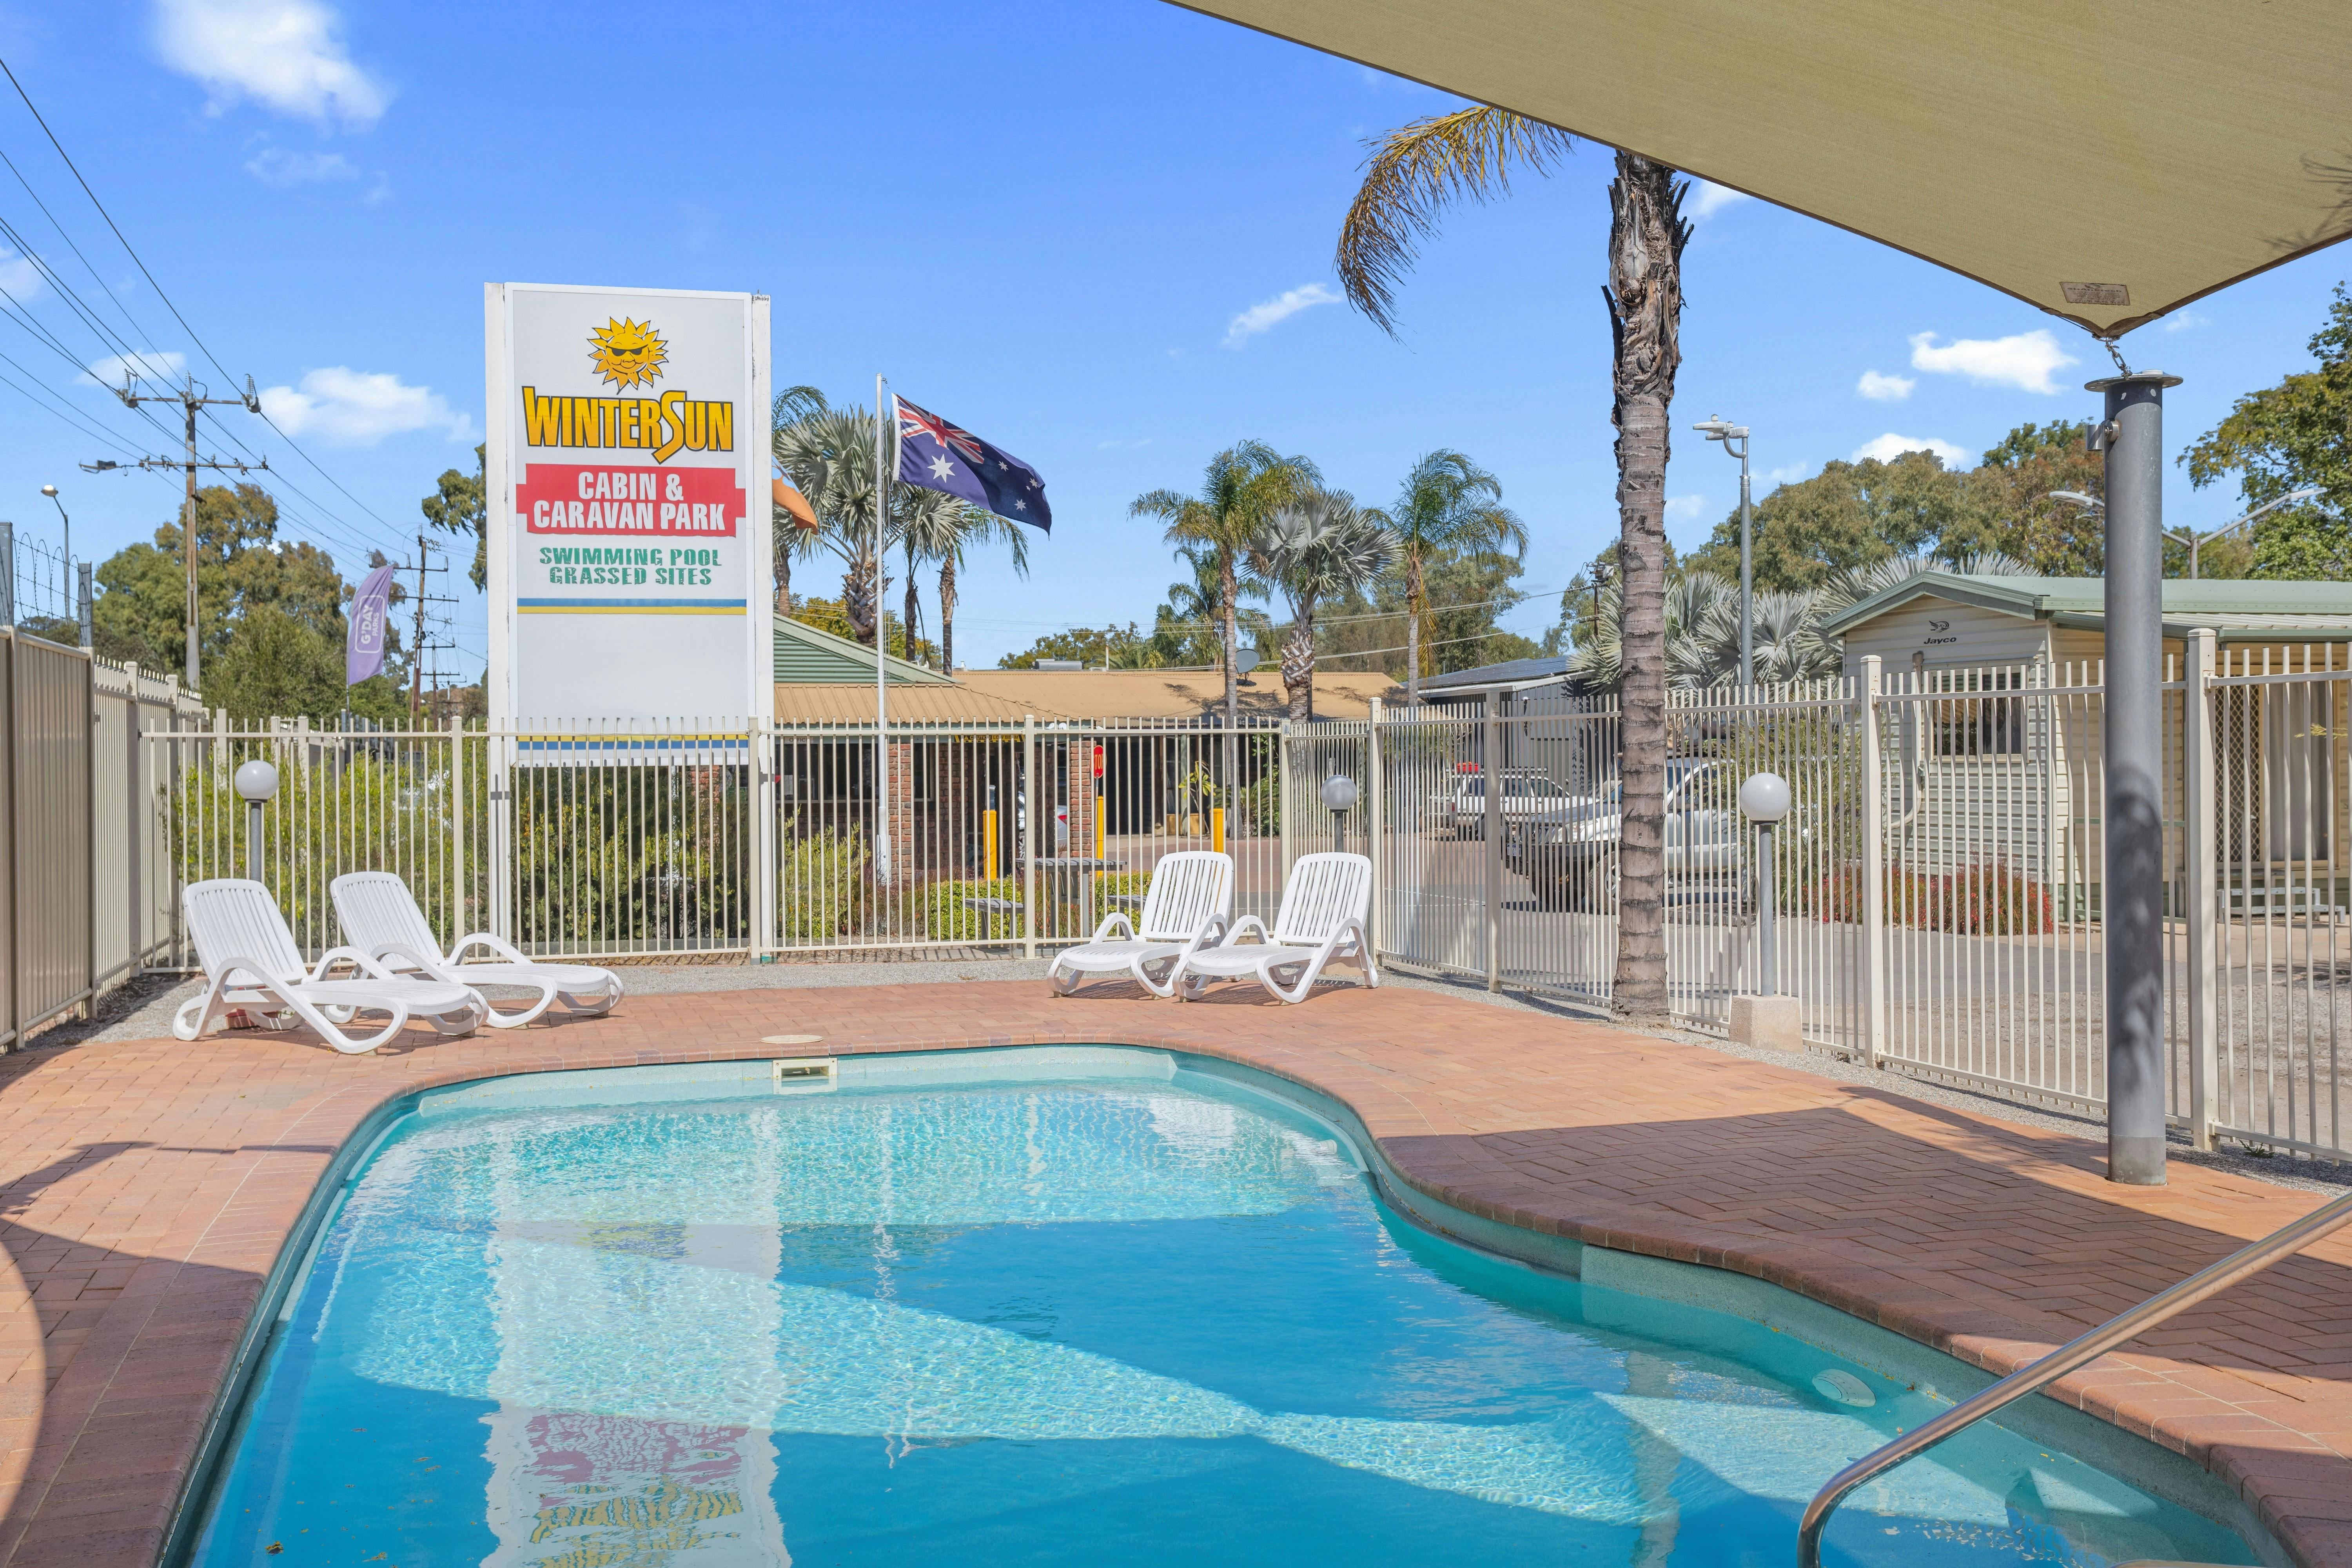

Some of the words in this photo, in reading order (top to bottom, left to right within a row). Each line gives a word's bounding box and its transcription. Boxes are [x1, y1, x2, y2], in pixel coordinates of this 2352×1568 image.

[579, 472, 656, 500] CABIN
[666, 474, 683, 501] &
[534, 501, 653, 529] CARAVAN
[661, 503, 725, 530] PARK
[540, 547, 662, 566] SWIMMING
[670, 549, 722, 566] POOL
[550, 567, 646, 585] GRASSED
[655, 568, 711, 585] SITES
[361, 604, 373, 644] G'DAY
